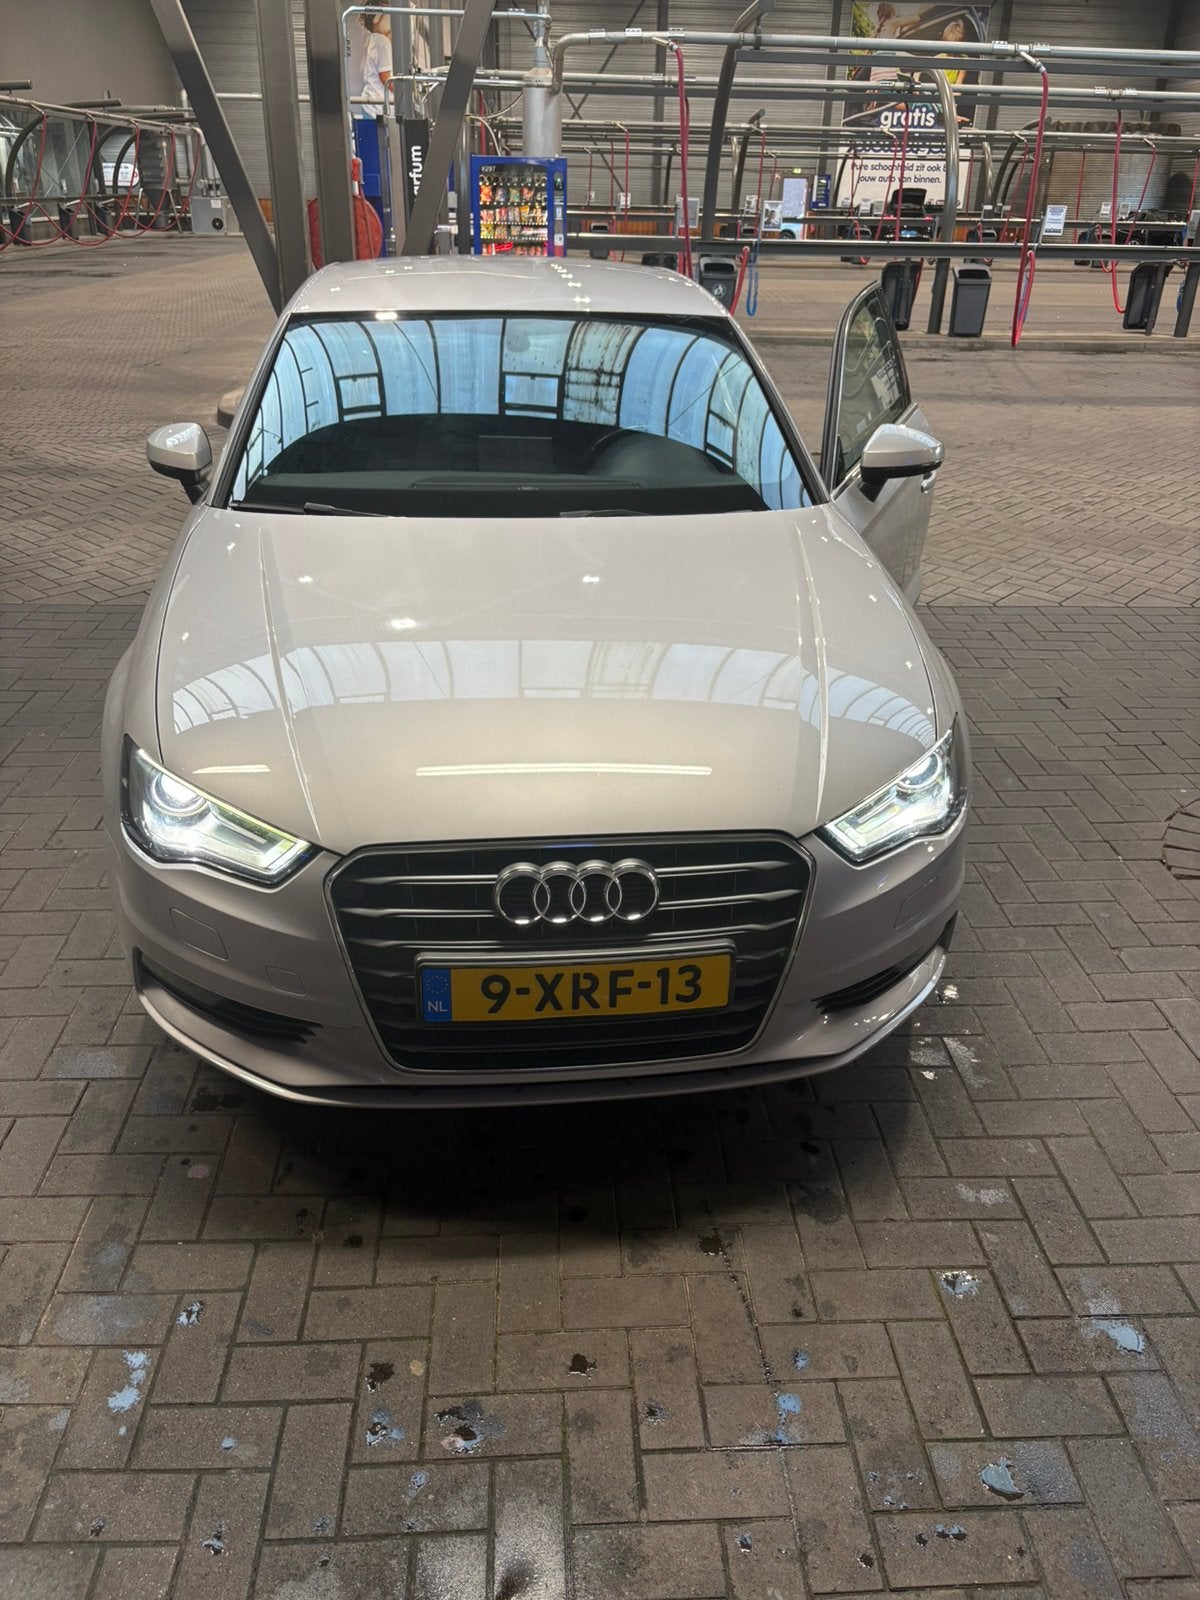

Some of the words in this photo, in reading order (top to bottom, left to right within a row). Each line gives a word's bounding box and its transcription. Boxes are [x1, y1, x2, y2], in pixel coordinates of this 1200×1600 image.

[880, 108, 935, 129] gratis
[409, 145, 424, 201] rfum
[916, 163, 925, 171] zit
[926, 164, 942, 172] ook
[913, 174, 942, 183] binnen.
[480, 964, 702, 1014] 9-XRF-13
[428, 1000, 449, 1012] NL
